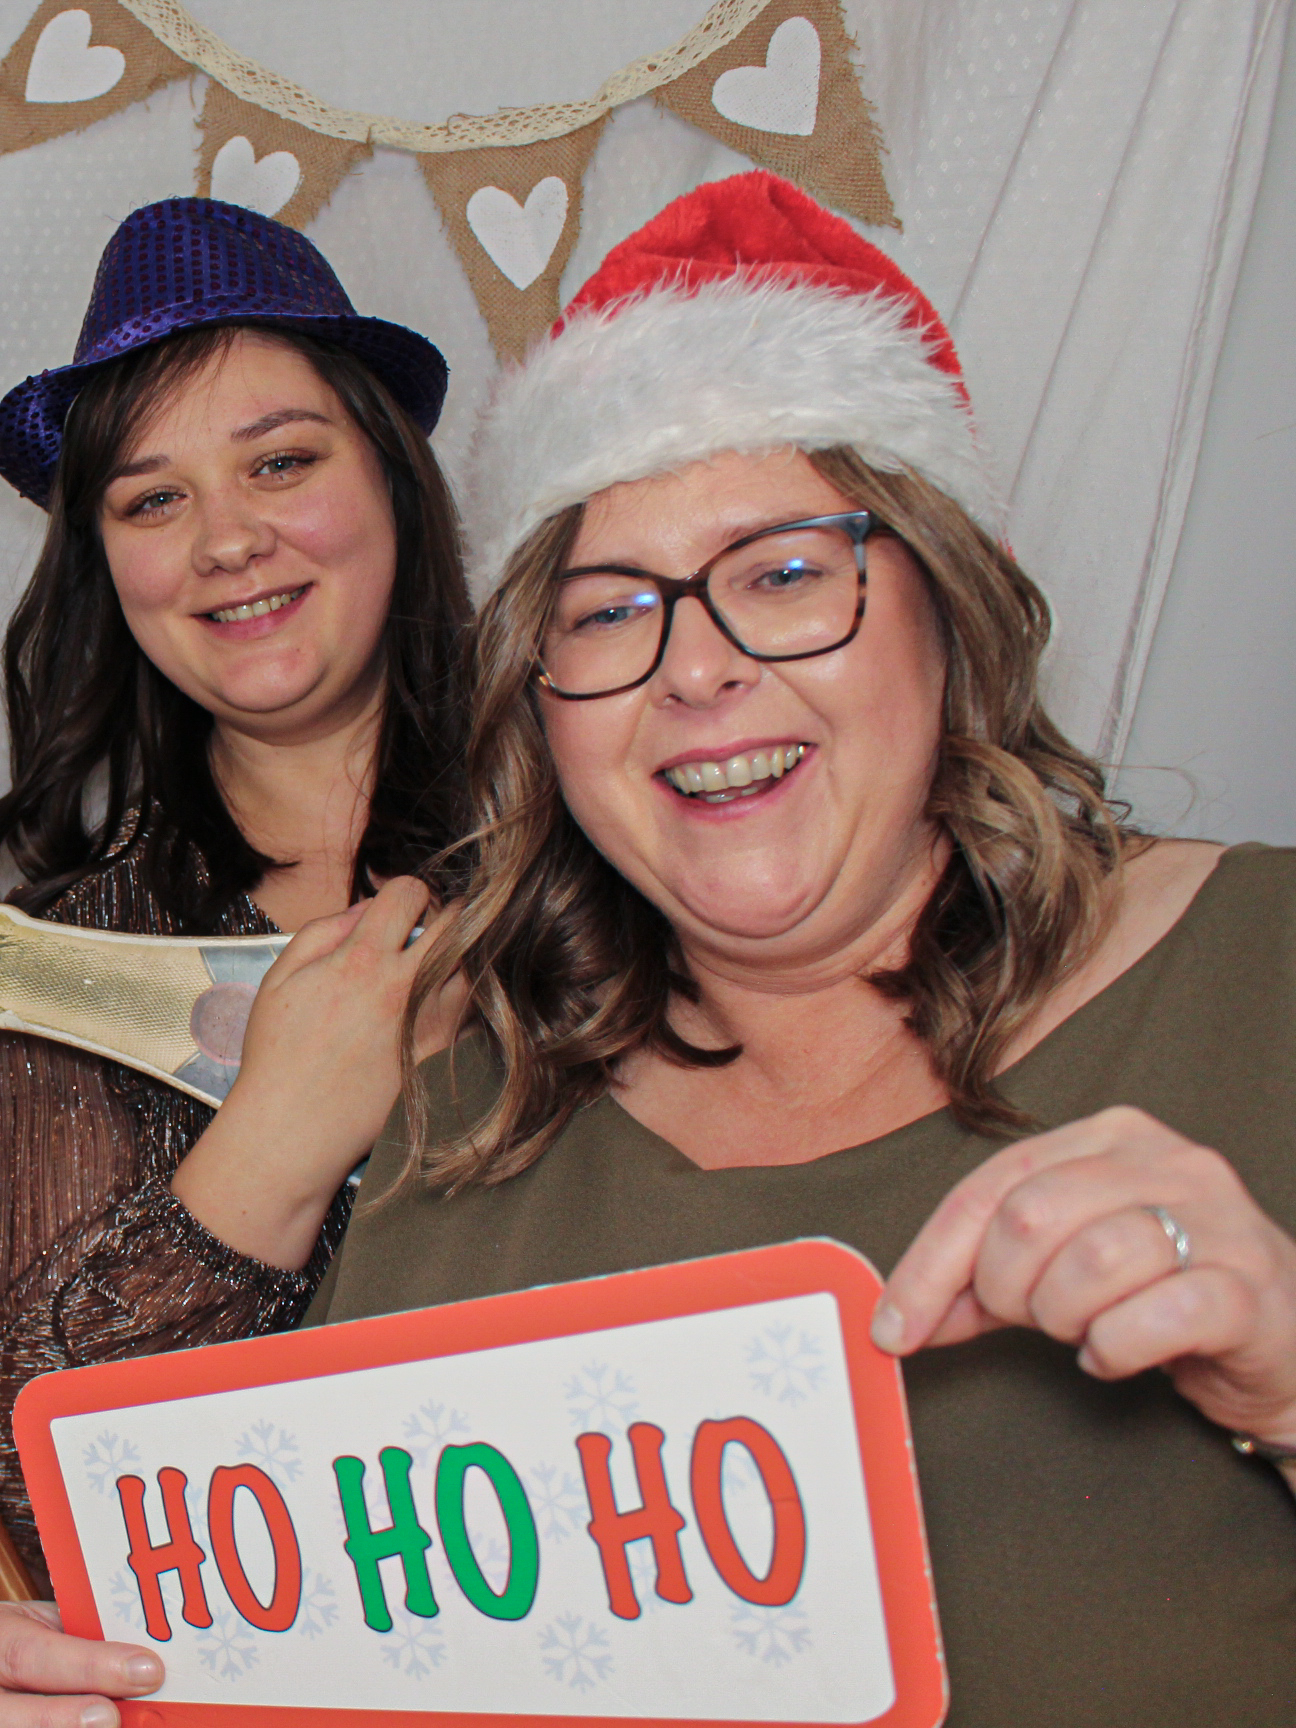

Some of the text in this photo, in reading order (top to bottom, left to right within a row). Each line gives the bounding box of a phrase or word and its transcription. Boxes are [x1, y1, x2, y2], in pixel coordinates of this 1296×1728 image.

[115, 1416, 807, 1643] HO HO HO
